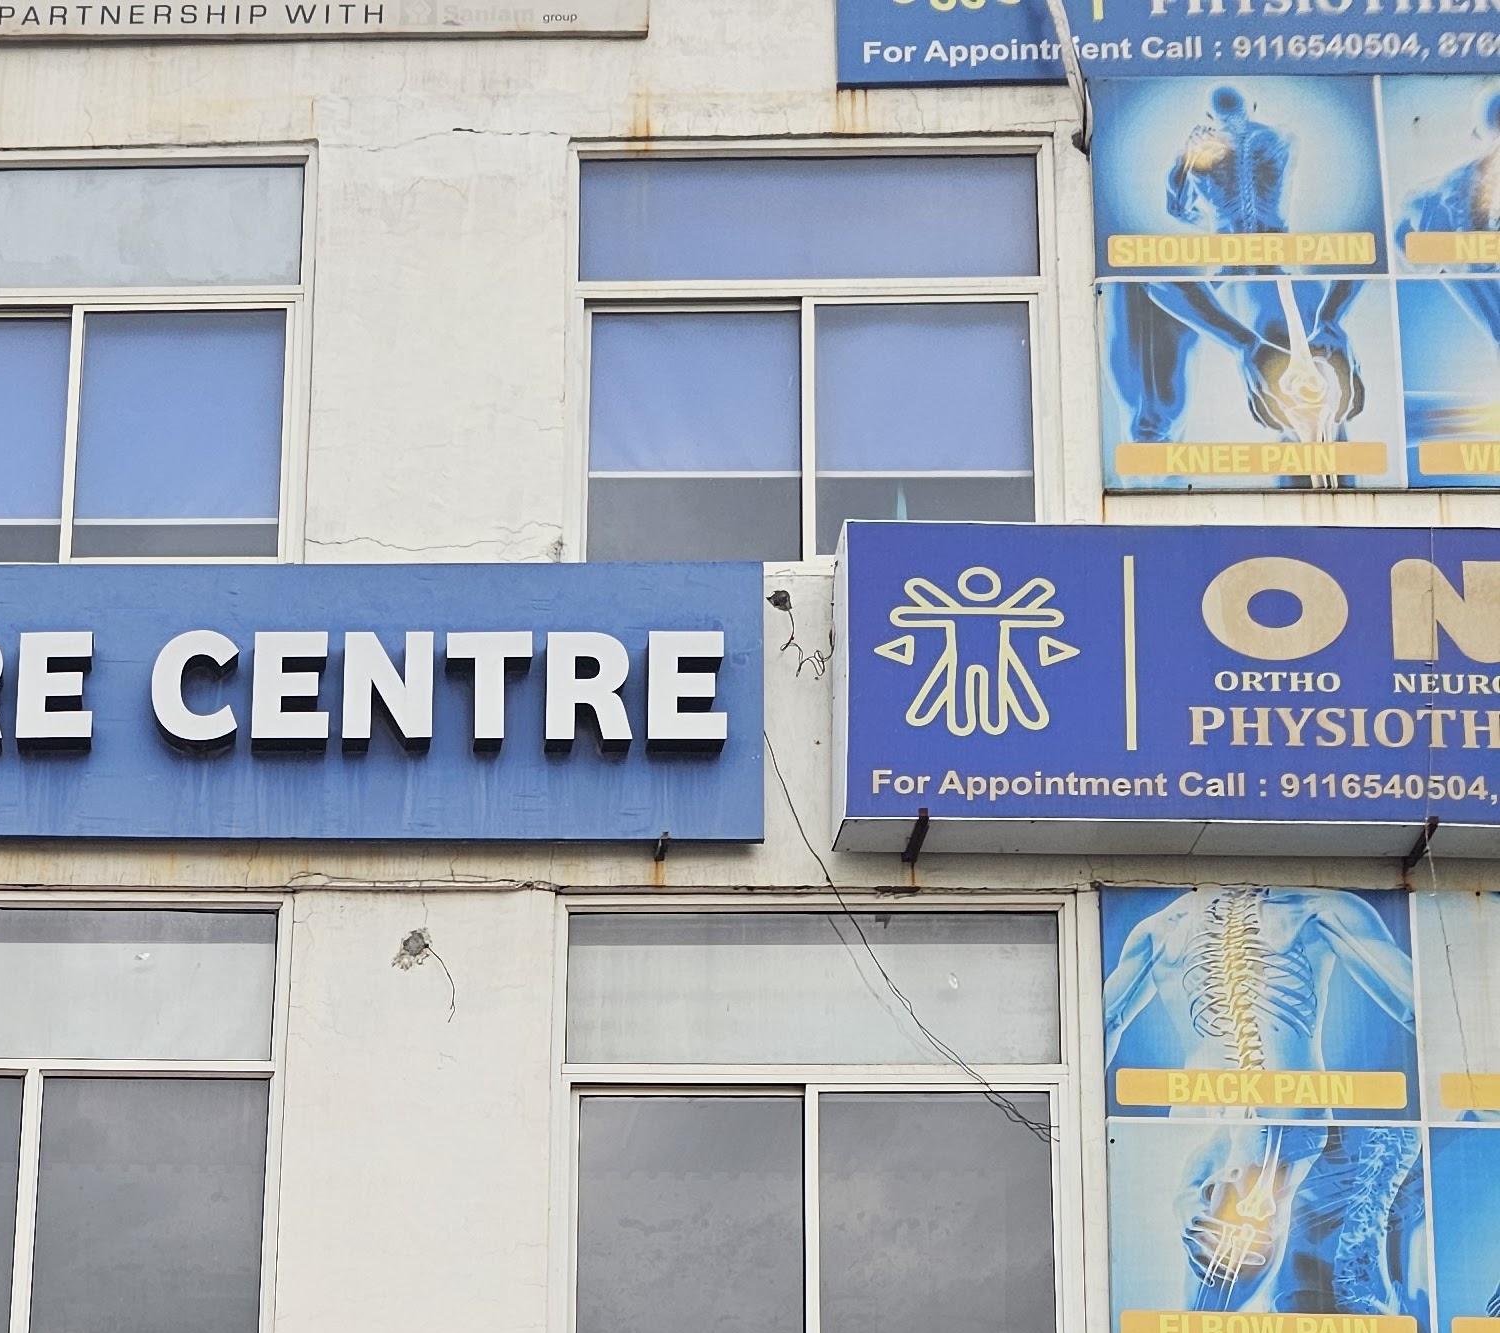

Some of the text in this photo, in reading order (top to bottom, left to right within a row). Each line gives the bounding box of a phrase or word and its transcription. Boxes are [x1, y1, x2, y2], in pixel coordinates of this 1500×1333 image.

[284, 4, 384, 25] WITH
[542, 13, 578, 24] group
[863, 40, 917, 63] For
[1141, 36, 1203, 60] Call
[1232, 32, 1431, 62] 9116540504,
[1114, 235, 1372, 264] SHOULDER PAIN
[1455, 234, 1500, 262] NE
[1166, 444, 1338, 474] KNEE PAIN
[150, 630, 729, 752] CENTRE
[1214, 670, 1500, 695] ORTHO NEUR
[872, 769, 1498, 805] For Appointment Call : 9116540504,
[1168, 1073, 1354, 1105] BACK PAIN
